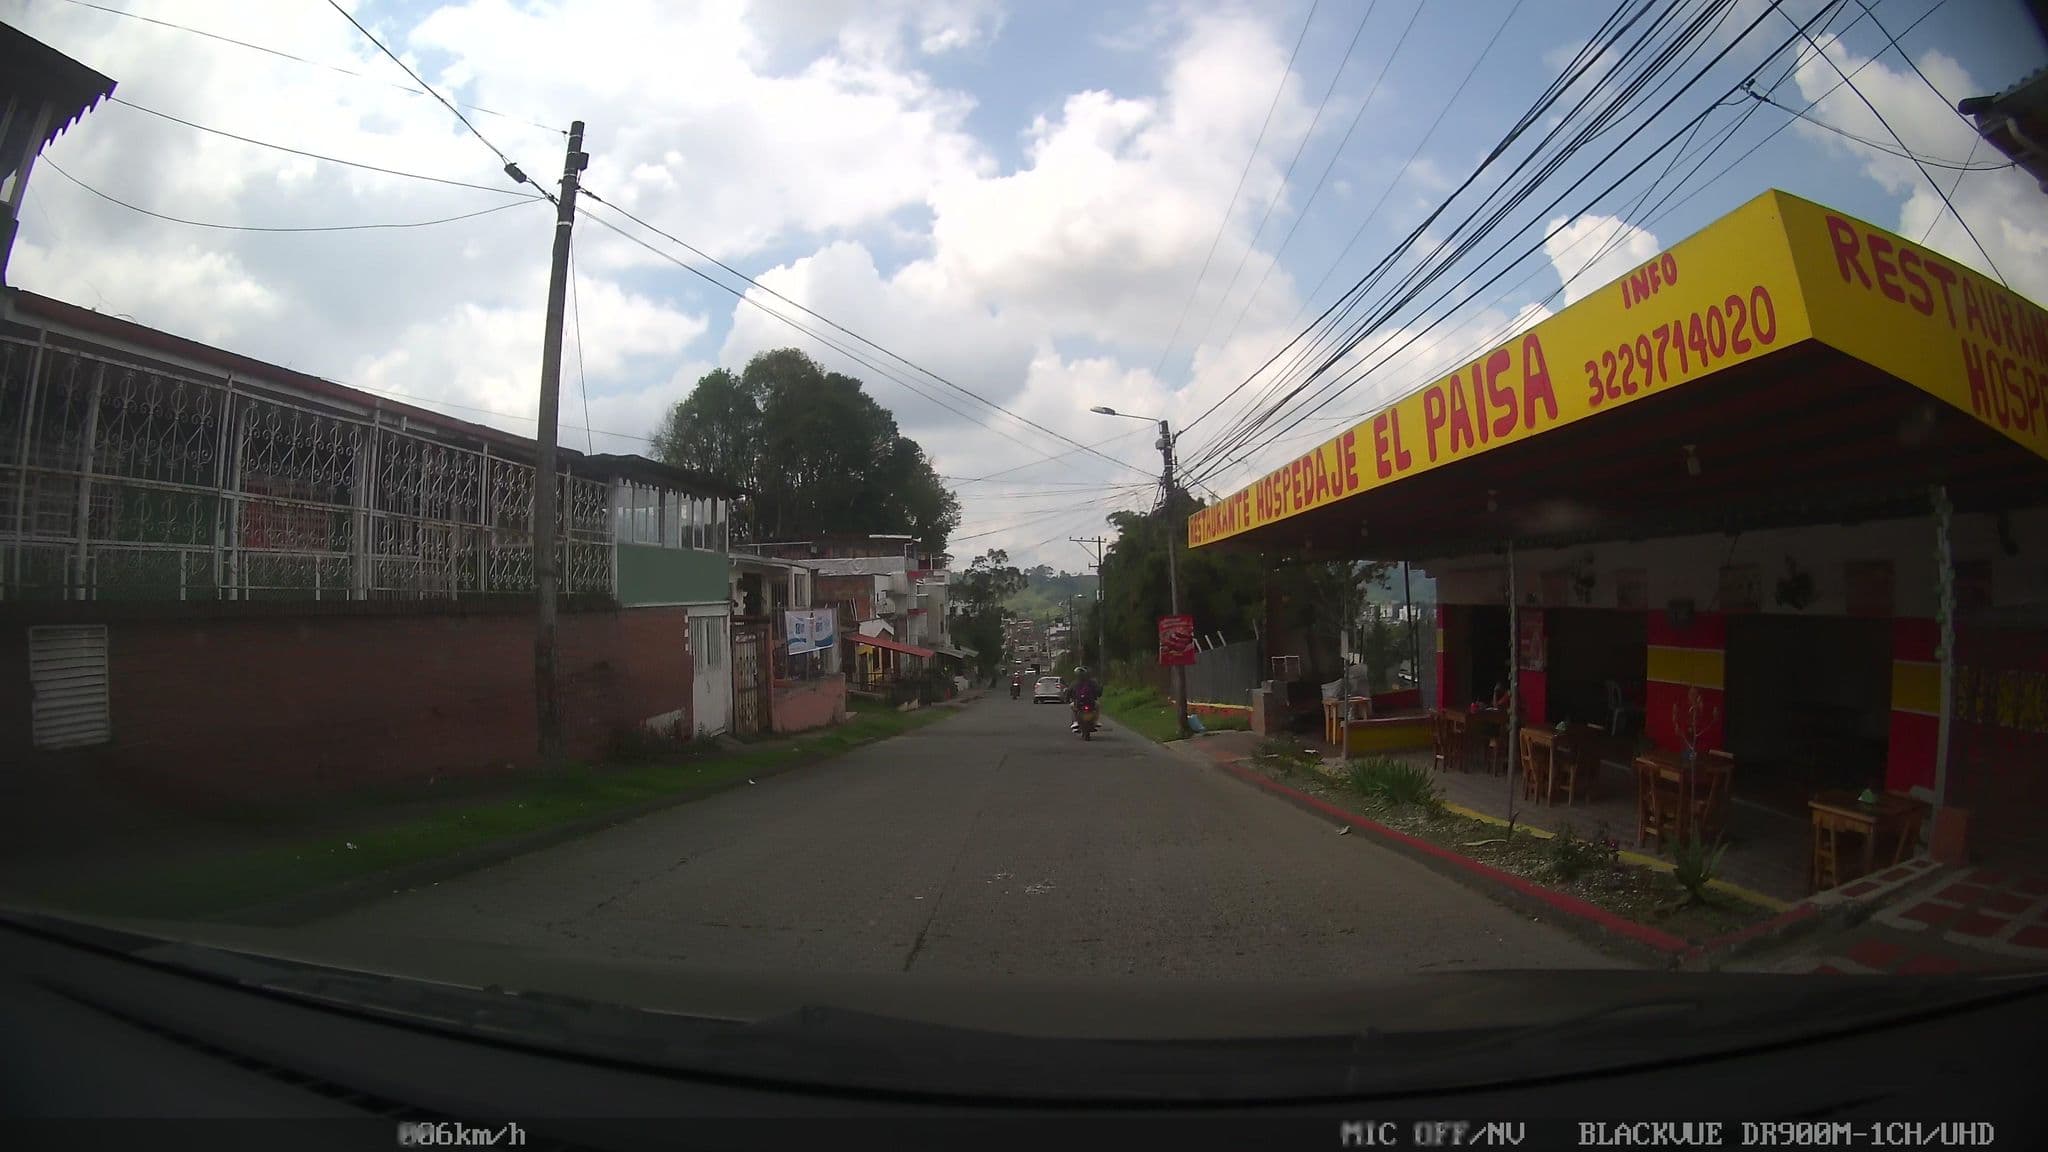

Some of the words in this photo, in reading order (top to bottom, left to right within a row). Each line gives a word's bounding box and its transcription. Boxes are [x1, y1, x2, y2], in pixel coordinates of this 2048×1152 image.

[1621, 252, 1678, 309] INFO
[1584, 285, 1777, 407] 3229714020
[1190, 489, 1250, 544] RESTAURANTE
[1256, 430, 1359, 522] HOSPEDAJE
[1372, 407, 1411, 479] EL
[1423, 332, 1559, 462] PAISA
